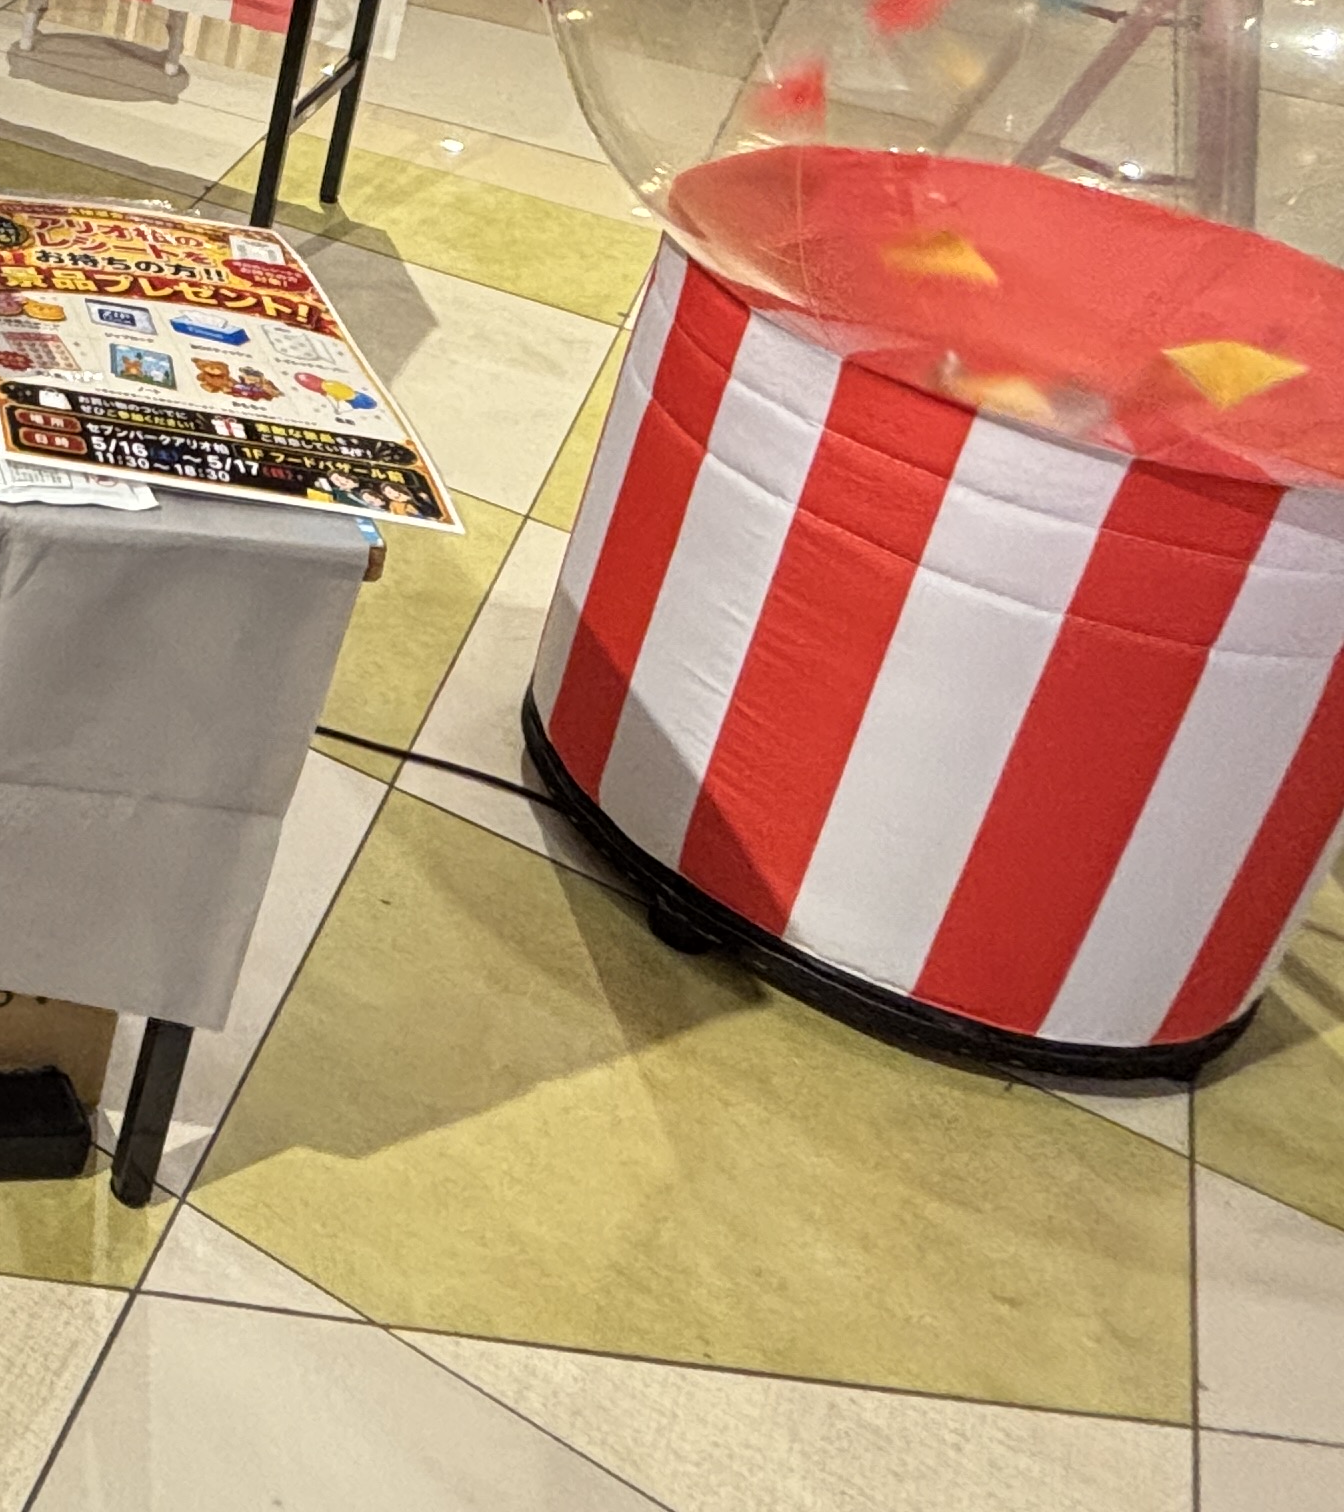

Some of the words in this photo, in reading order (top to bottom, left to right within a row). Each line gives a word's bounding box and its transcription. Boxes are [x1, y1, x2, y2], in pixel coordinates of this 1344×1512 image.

[0, 266, 310, 324] 景品プレゼント!
[86, 422, 230, 456] セブンパークアリオ柏
[95, 452, 150, 470] 11:30
